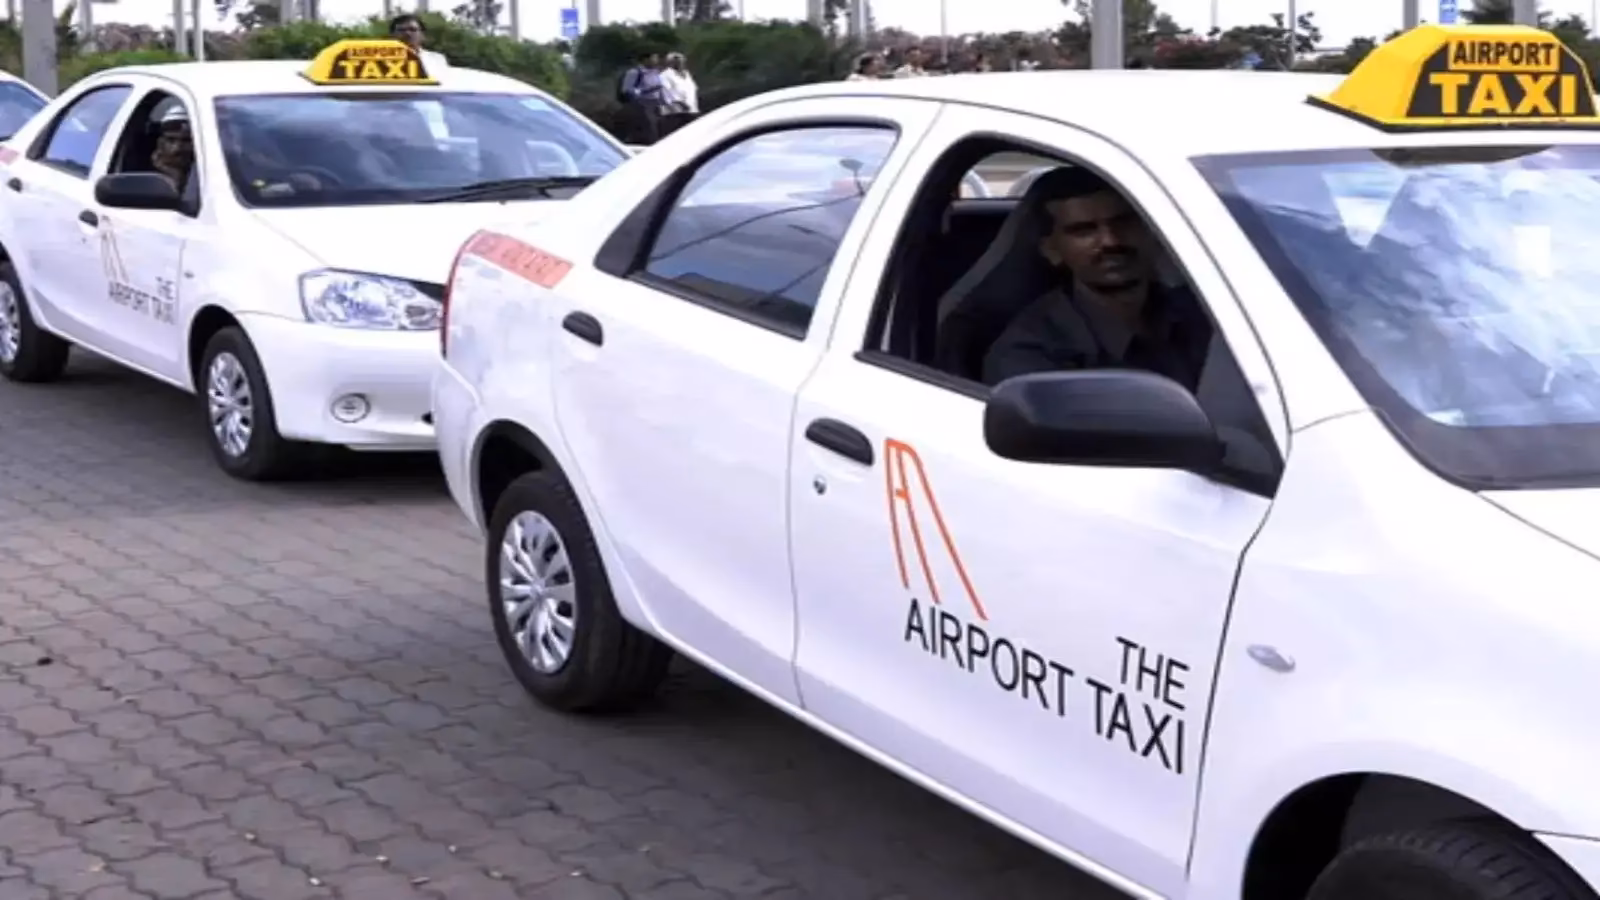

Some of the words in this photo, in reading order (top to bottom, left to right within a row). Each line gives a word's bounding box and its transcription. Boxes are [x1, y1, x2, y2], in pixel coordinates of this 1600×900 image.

[350, 46, 404, 57] AIRPORT
[1453, 41, 1554, 65] AIRPORT
[339, 60, 418, 78] TAXI
[1430, 73, 1577, 114] TAXI
[151, 295, 176, 325] TAXI
[904, 598, 1074, 717] AIRPORT
[1086, 678, 1184, 774] TAXI
[1115, 637, 1190, 710] THE
